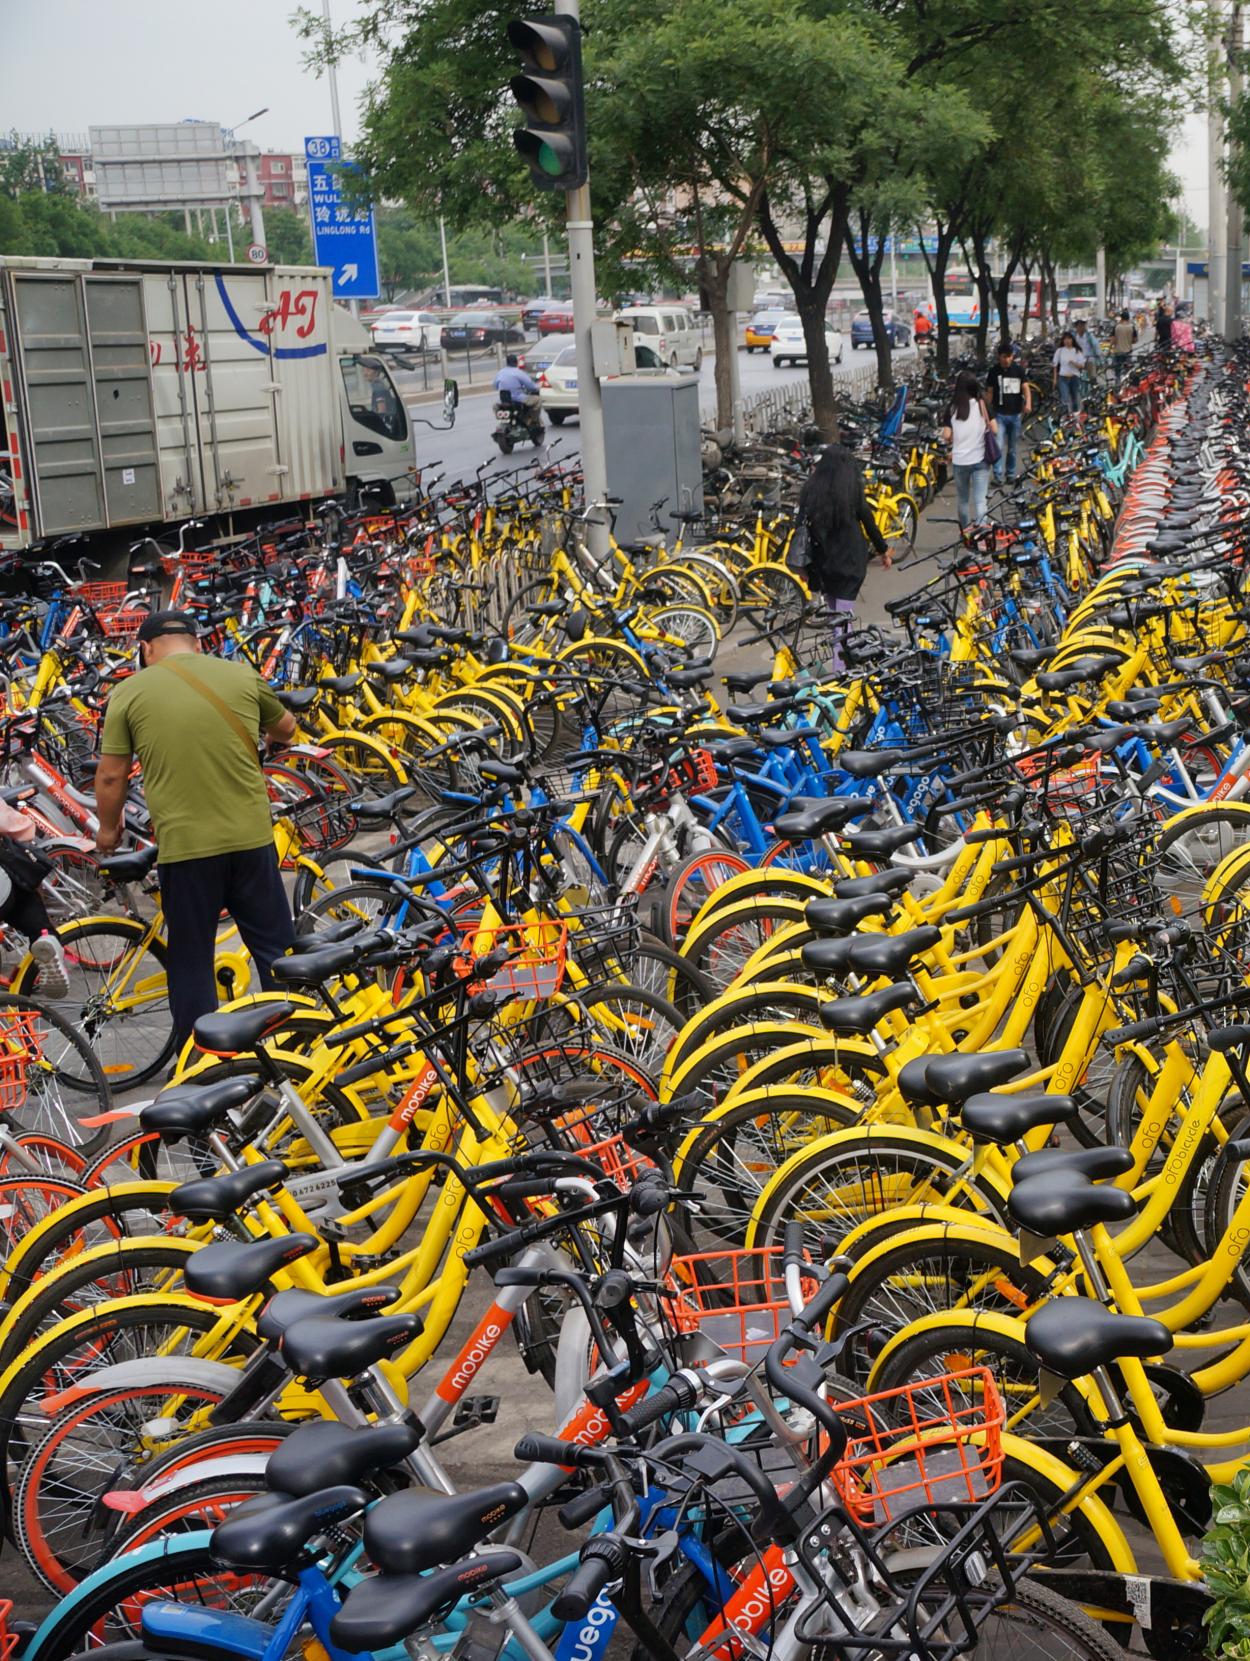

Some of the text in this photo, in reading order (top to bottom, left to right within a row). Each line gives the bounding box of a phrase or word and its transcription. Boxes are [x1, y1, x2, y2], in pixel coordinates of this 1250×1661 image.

[311, 141, 326, 155] 38
[316, 225, 371, 235] LINGLONG Rd
[251, 249, 265, 259] 80
[953, 864, 968, 885] ofo
[970, 874, 985, 896] ofo
[1014, 951, 1029, 976] ofo
[1023, 982, 1040, 1008] ofo
[1055, 1062, 1074, 1090] ofo
[399, 1069, 438, 1123] mobike
[429, 1123, 448, 1150] ofo
[1142, 1121, 1161, 1149] ofo
[1165, 1119, 1201, 1185] ofobicycle
[444, 1176, 465, 1207] ofo
[456, 1227, 475, 1260] ofo
[1227, 1227, 1250, 1257] ofo
[451, 1323, 501, 1391] mobike
[481, 1503, 506, 1524] mobike
[457, 1564, 488, 1582] mobike
